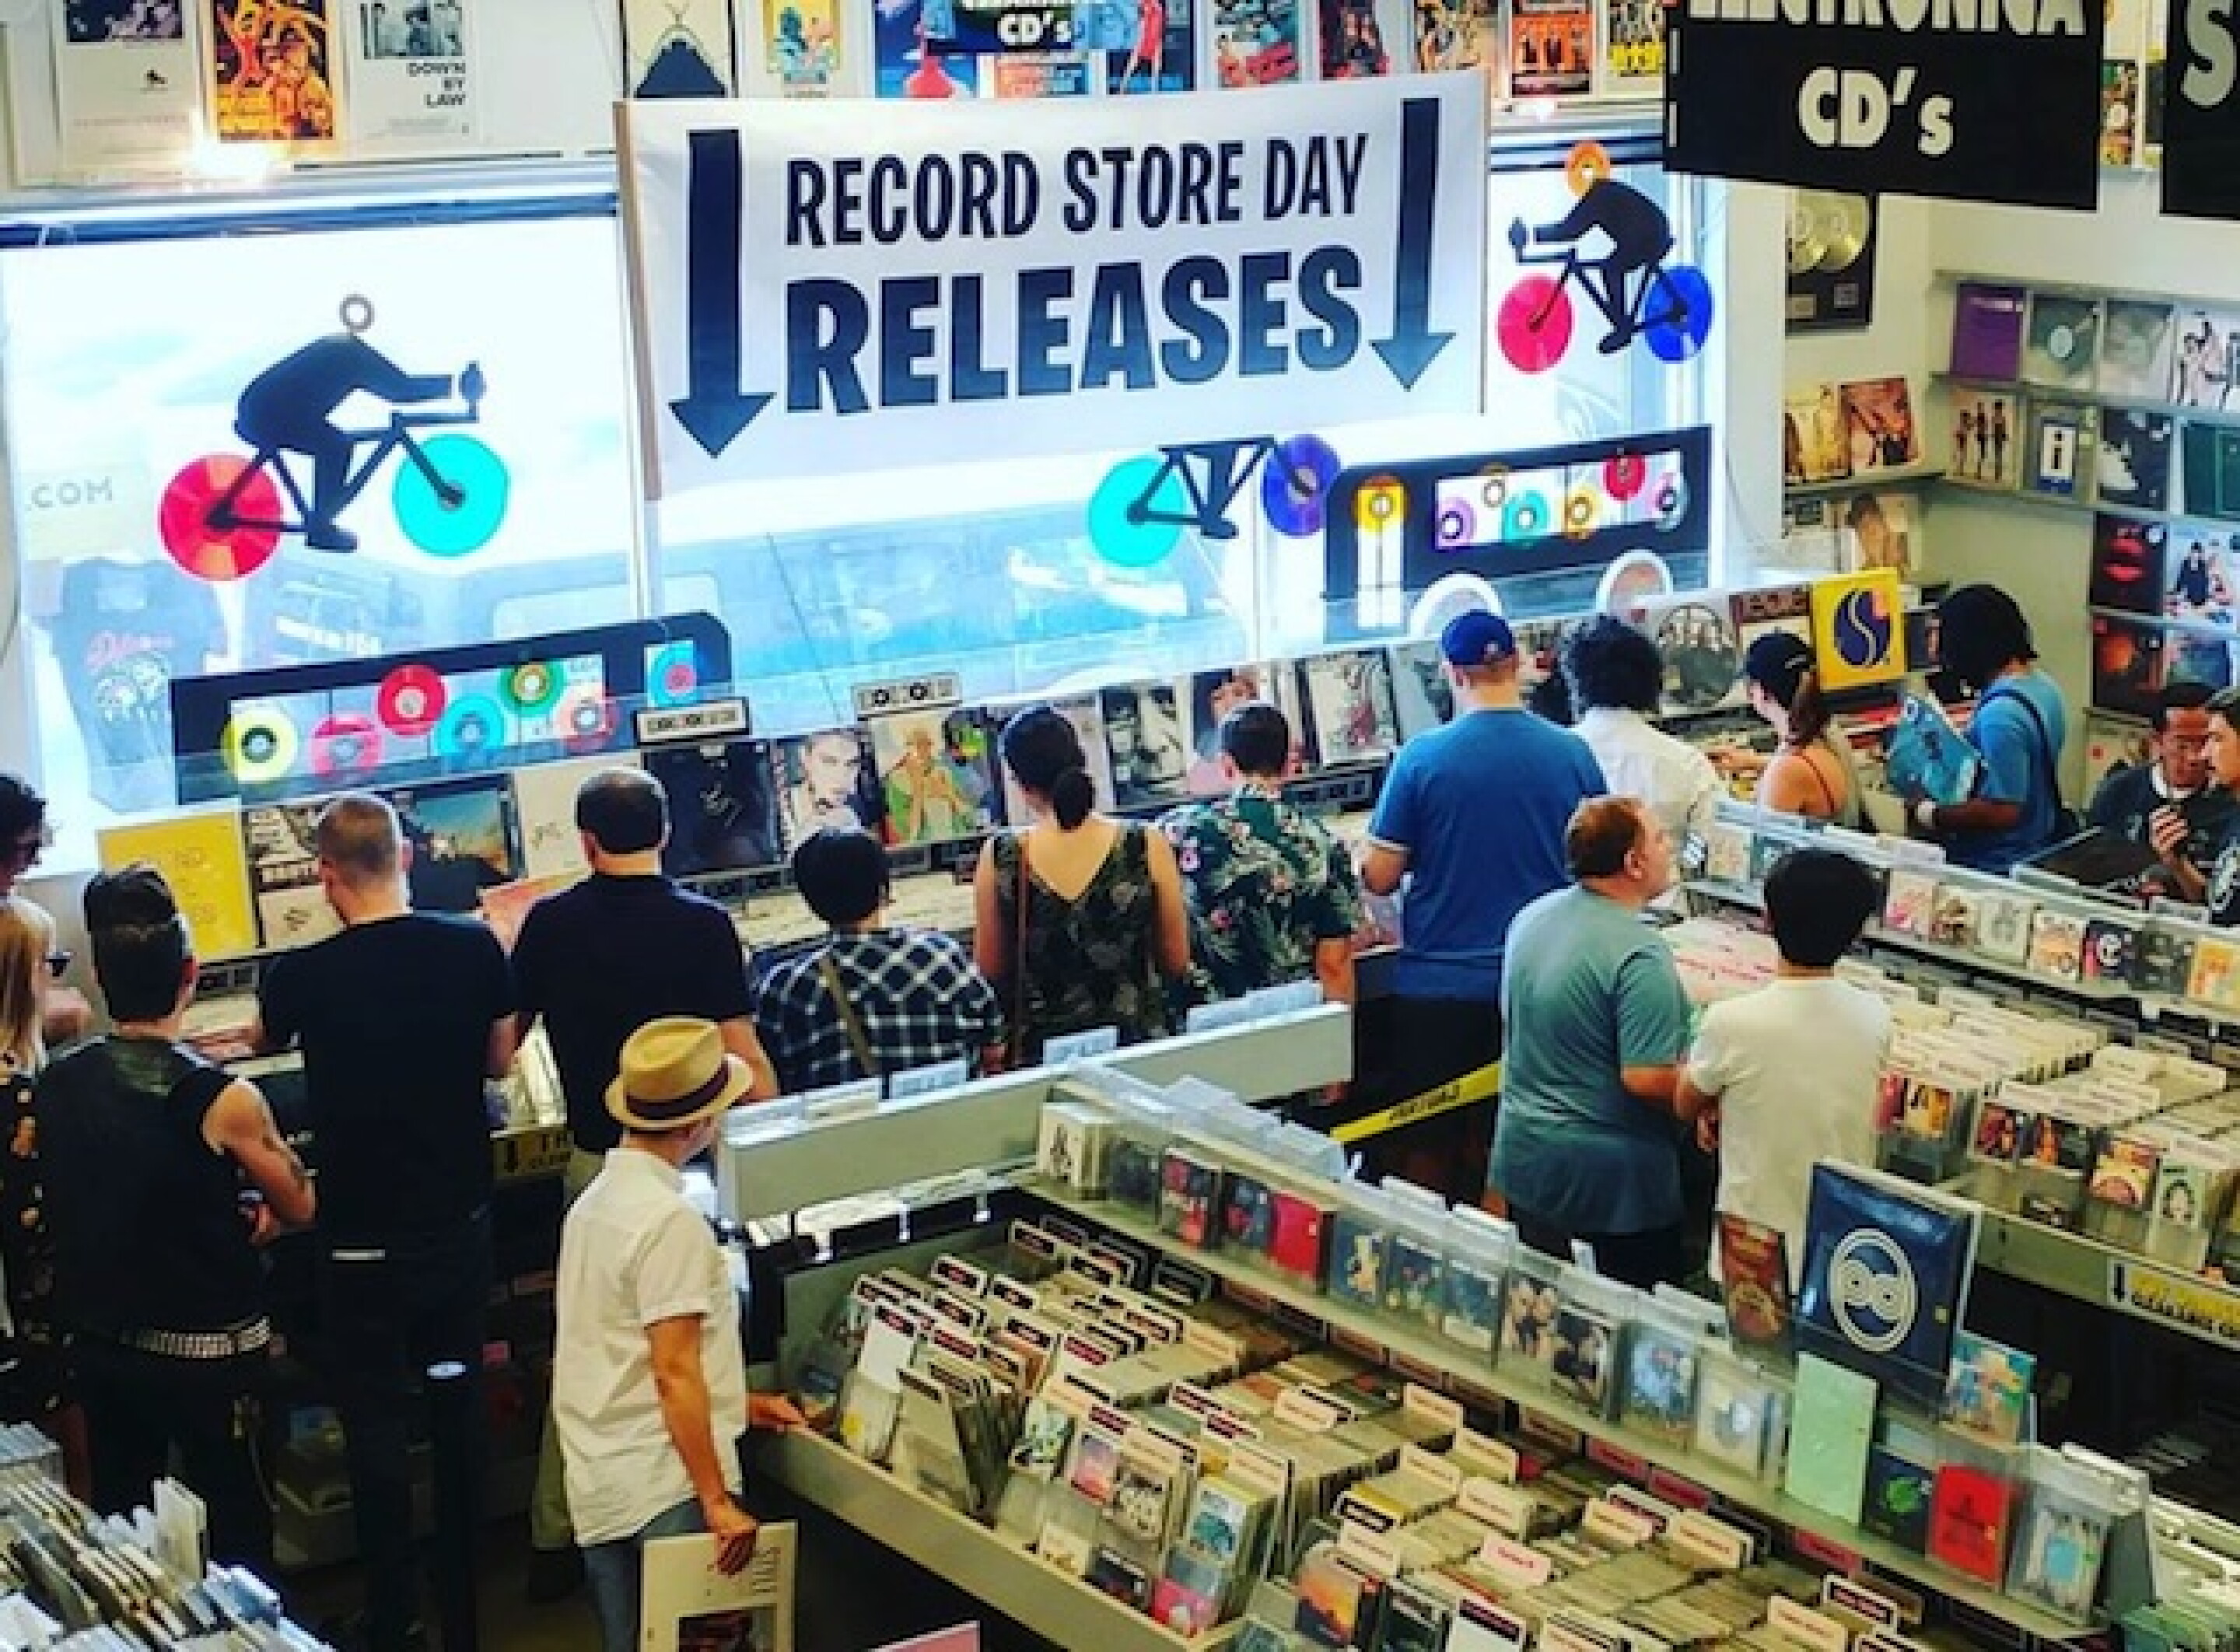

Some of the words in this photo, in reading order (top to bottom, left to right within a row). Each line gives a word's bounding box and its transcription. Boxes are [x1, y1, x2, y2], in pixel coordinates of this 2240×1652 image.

[997, 11, 1072, 44] CD's
[407, 62, 466, 76] DOWN
[443, 77, 466, 91] BY
[424, 94, 466, 108] LAW
[1798, 67, 1954, 155] CD's
[786, 151, 1041, 248] RECORD
[1063, 140, 1244, 232] STORE
[1263, 132, 1369, 221] DAY
[786, 244, 1363, 417] RELEASES
